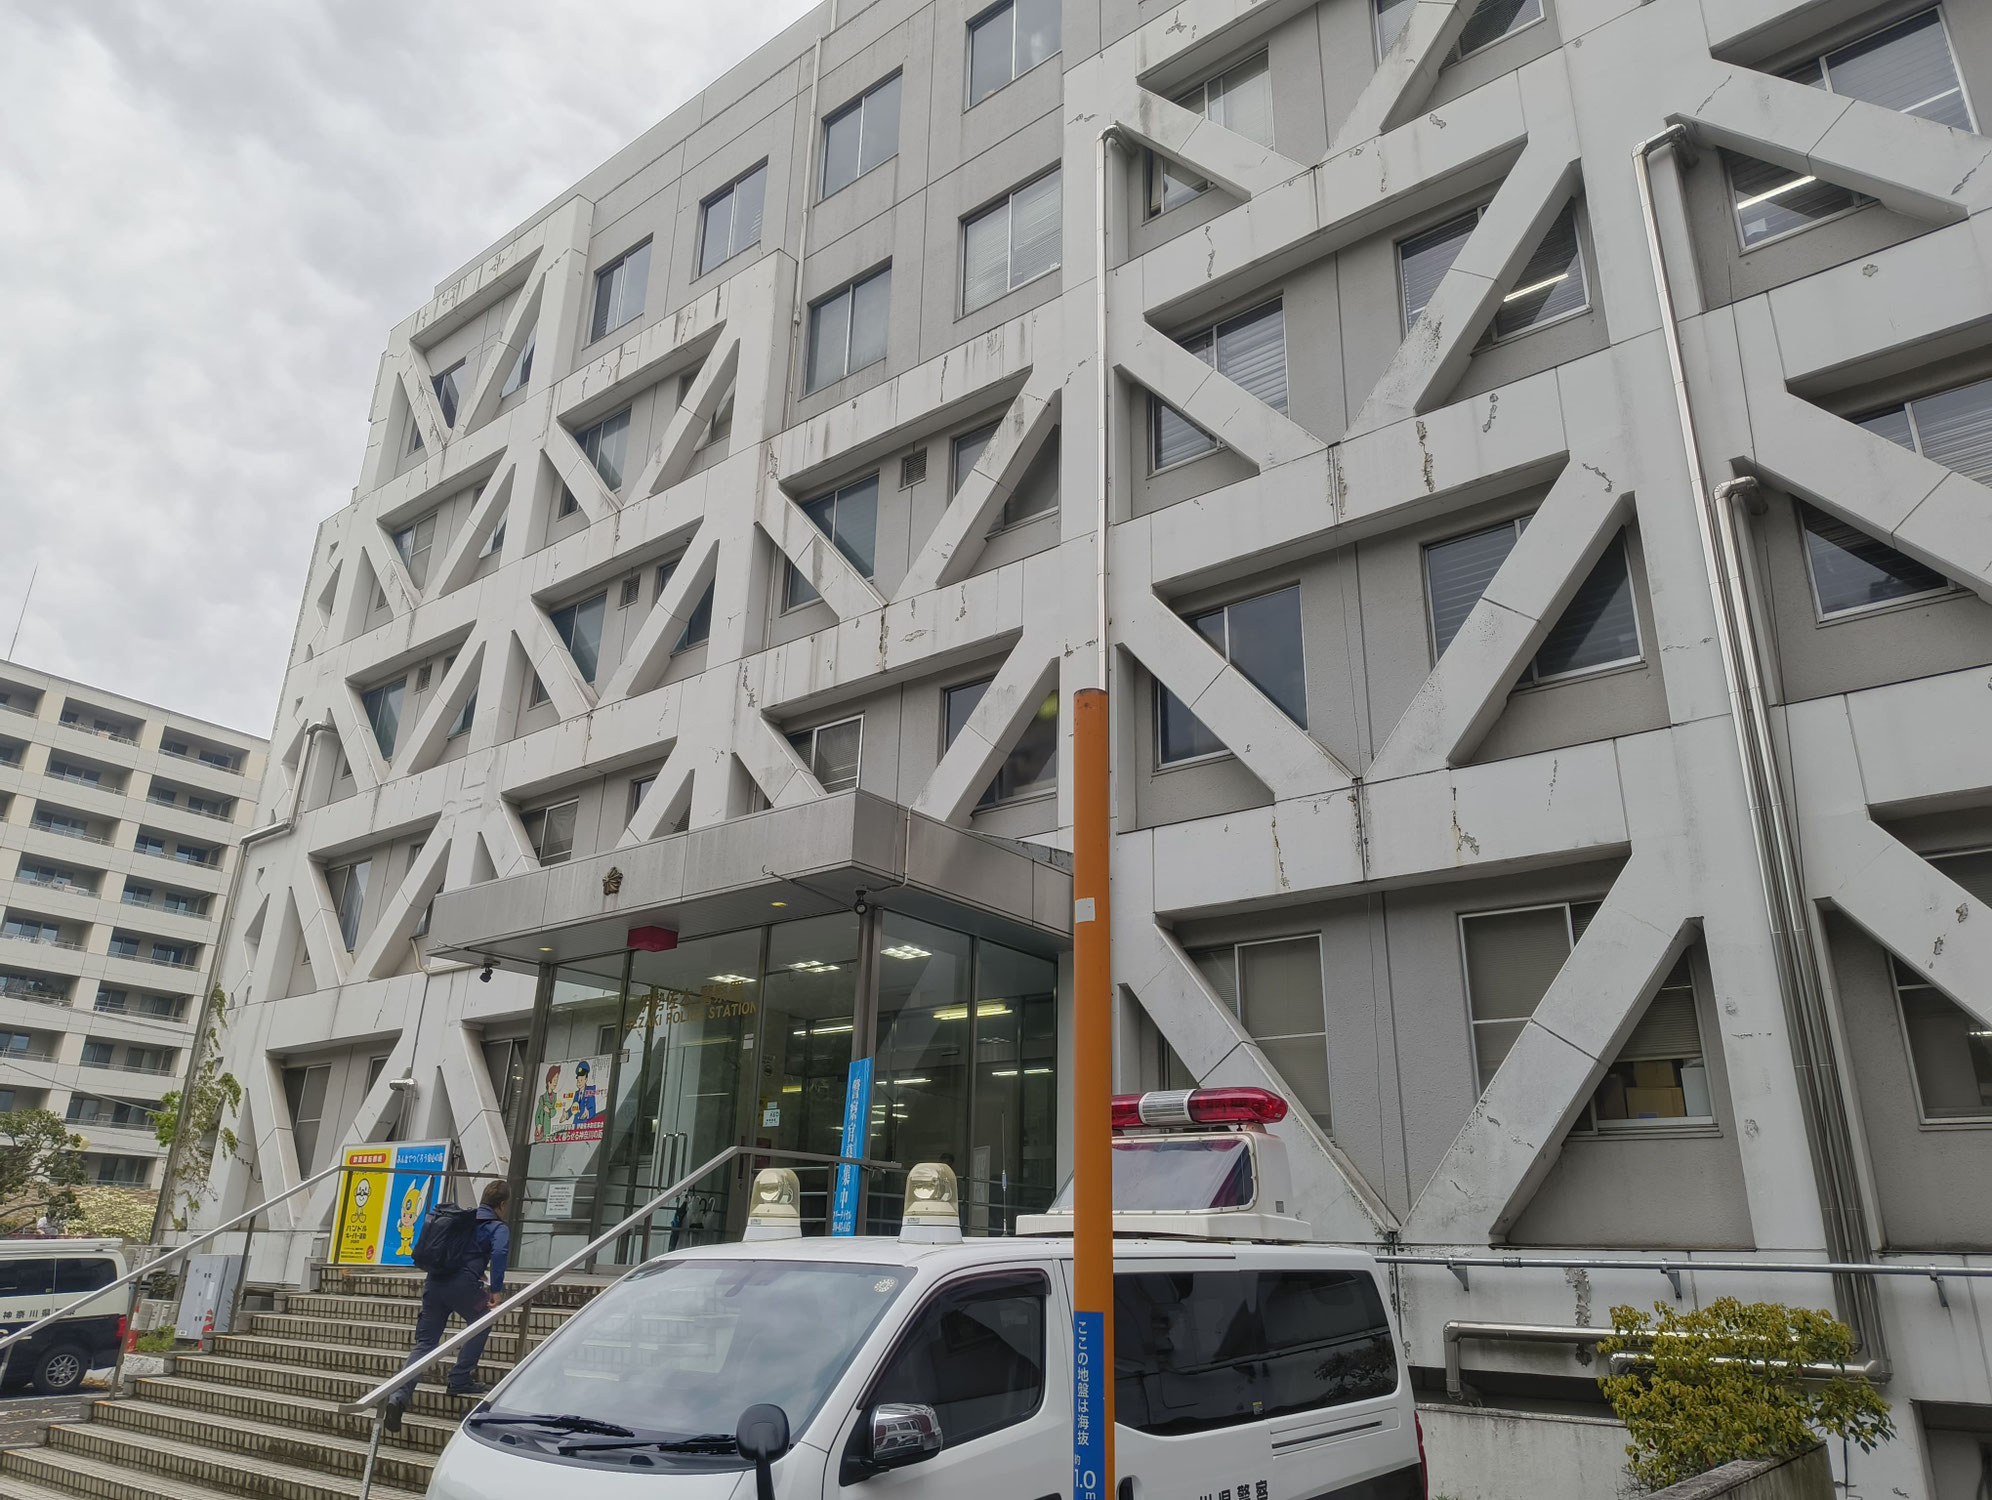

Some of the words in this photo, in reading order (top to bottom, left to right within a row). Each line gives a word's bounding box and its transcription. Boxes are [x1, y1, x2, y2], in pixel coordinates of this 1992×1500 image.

[666, 1008, 703, 1024] POL
[709, 1001, 757, 1019] STATION
[1077, 1321, 1090, 1446] ここの地盤は海抜
[1200, 1480, 1268, 1500] 警察
